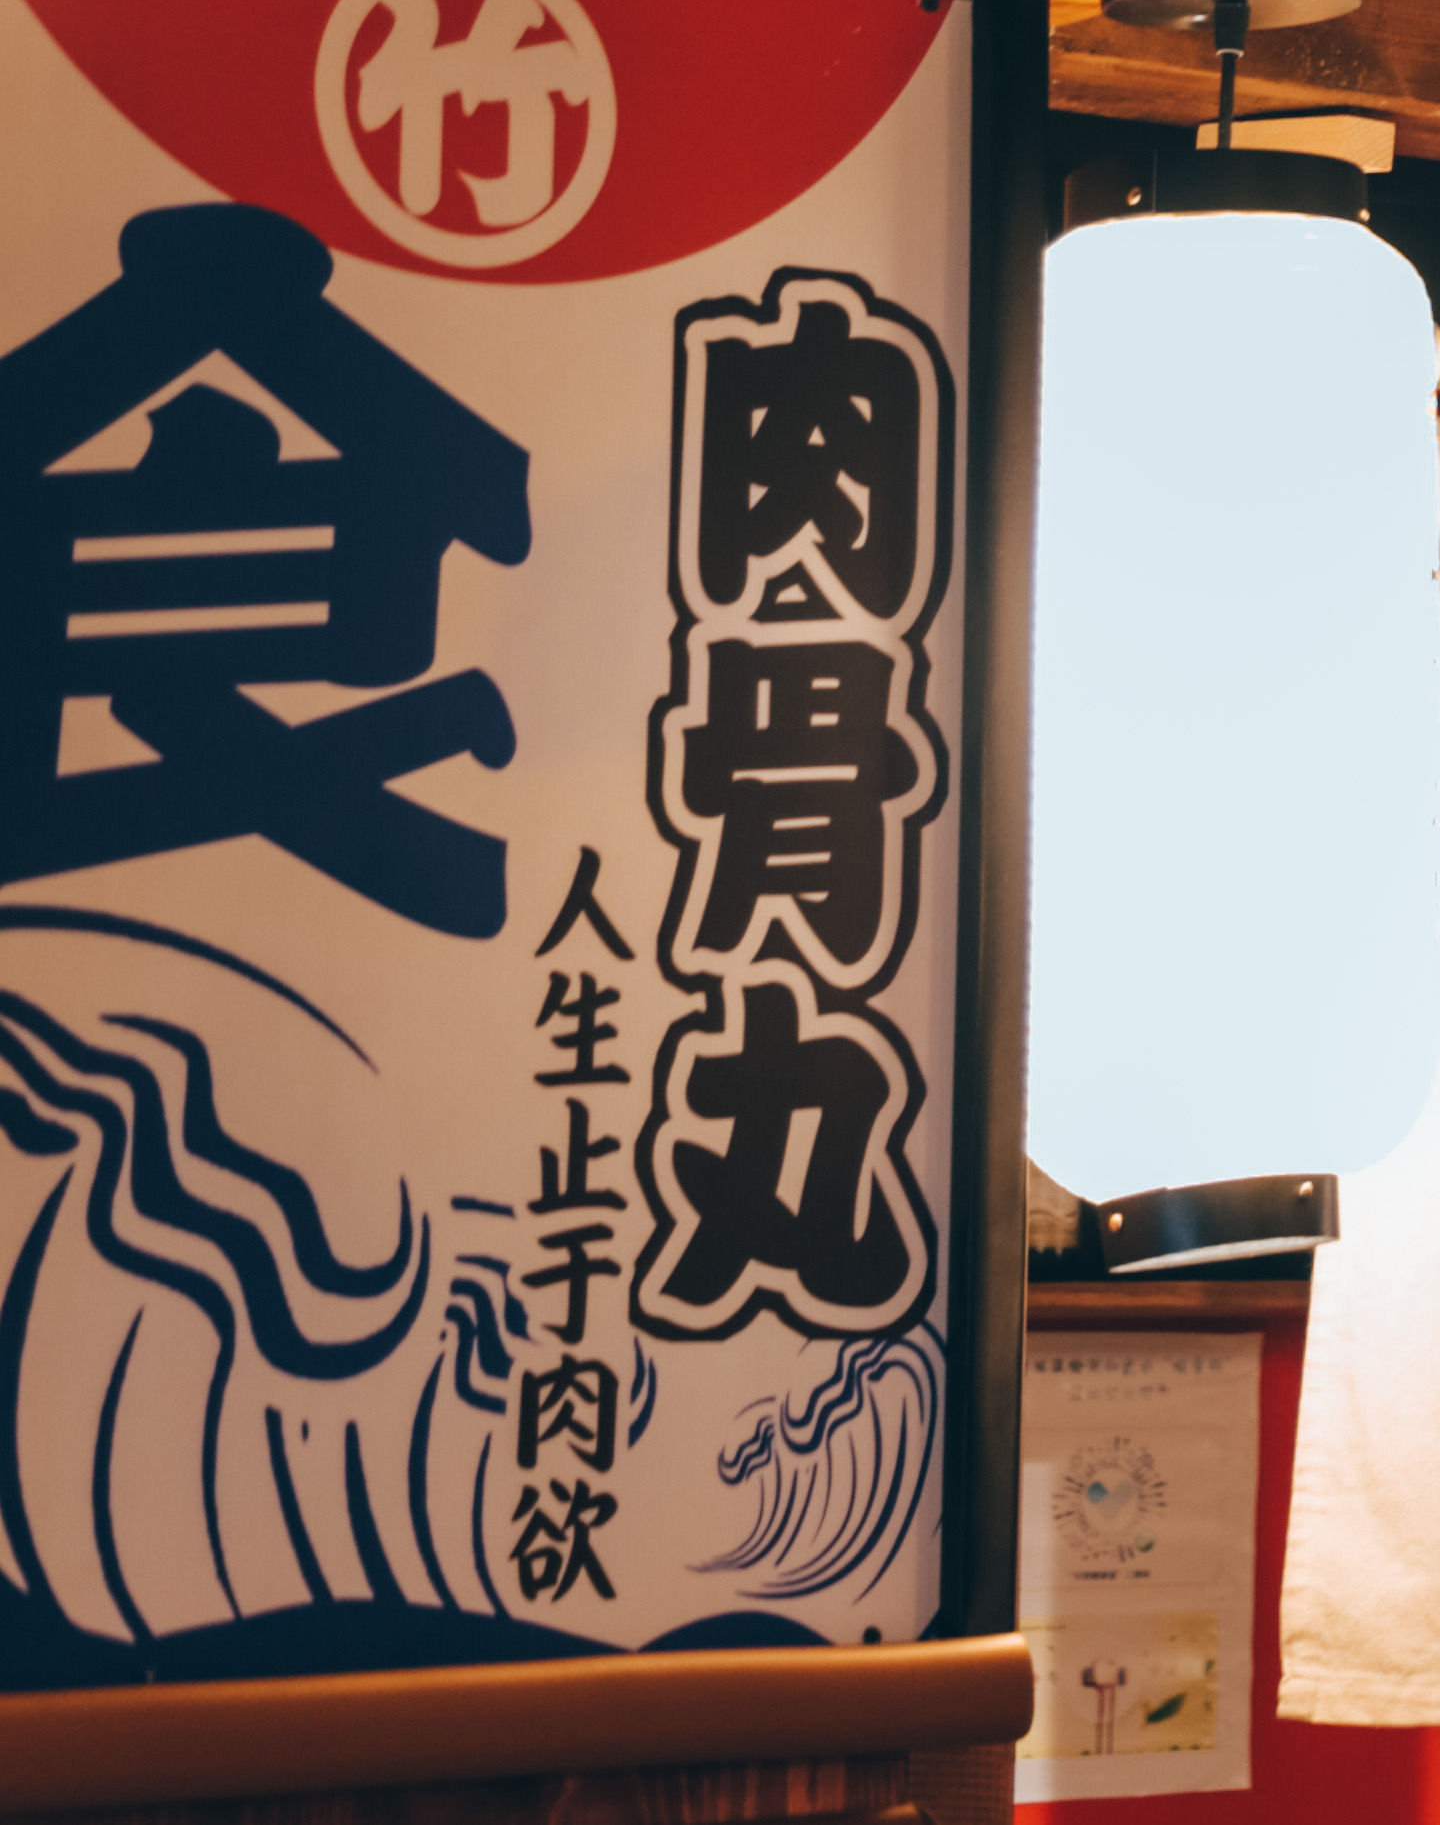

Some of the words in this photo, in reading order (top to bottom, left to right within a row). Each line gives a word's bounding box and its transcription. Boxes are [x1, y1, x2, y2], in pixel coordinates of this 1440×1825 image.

[0, 201, 534, 937] 食
[630, 265, 956, 1341] 肉骨丸
[509, 843, 636, 1604] 人生止于肉欲
